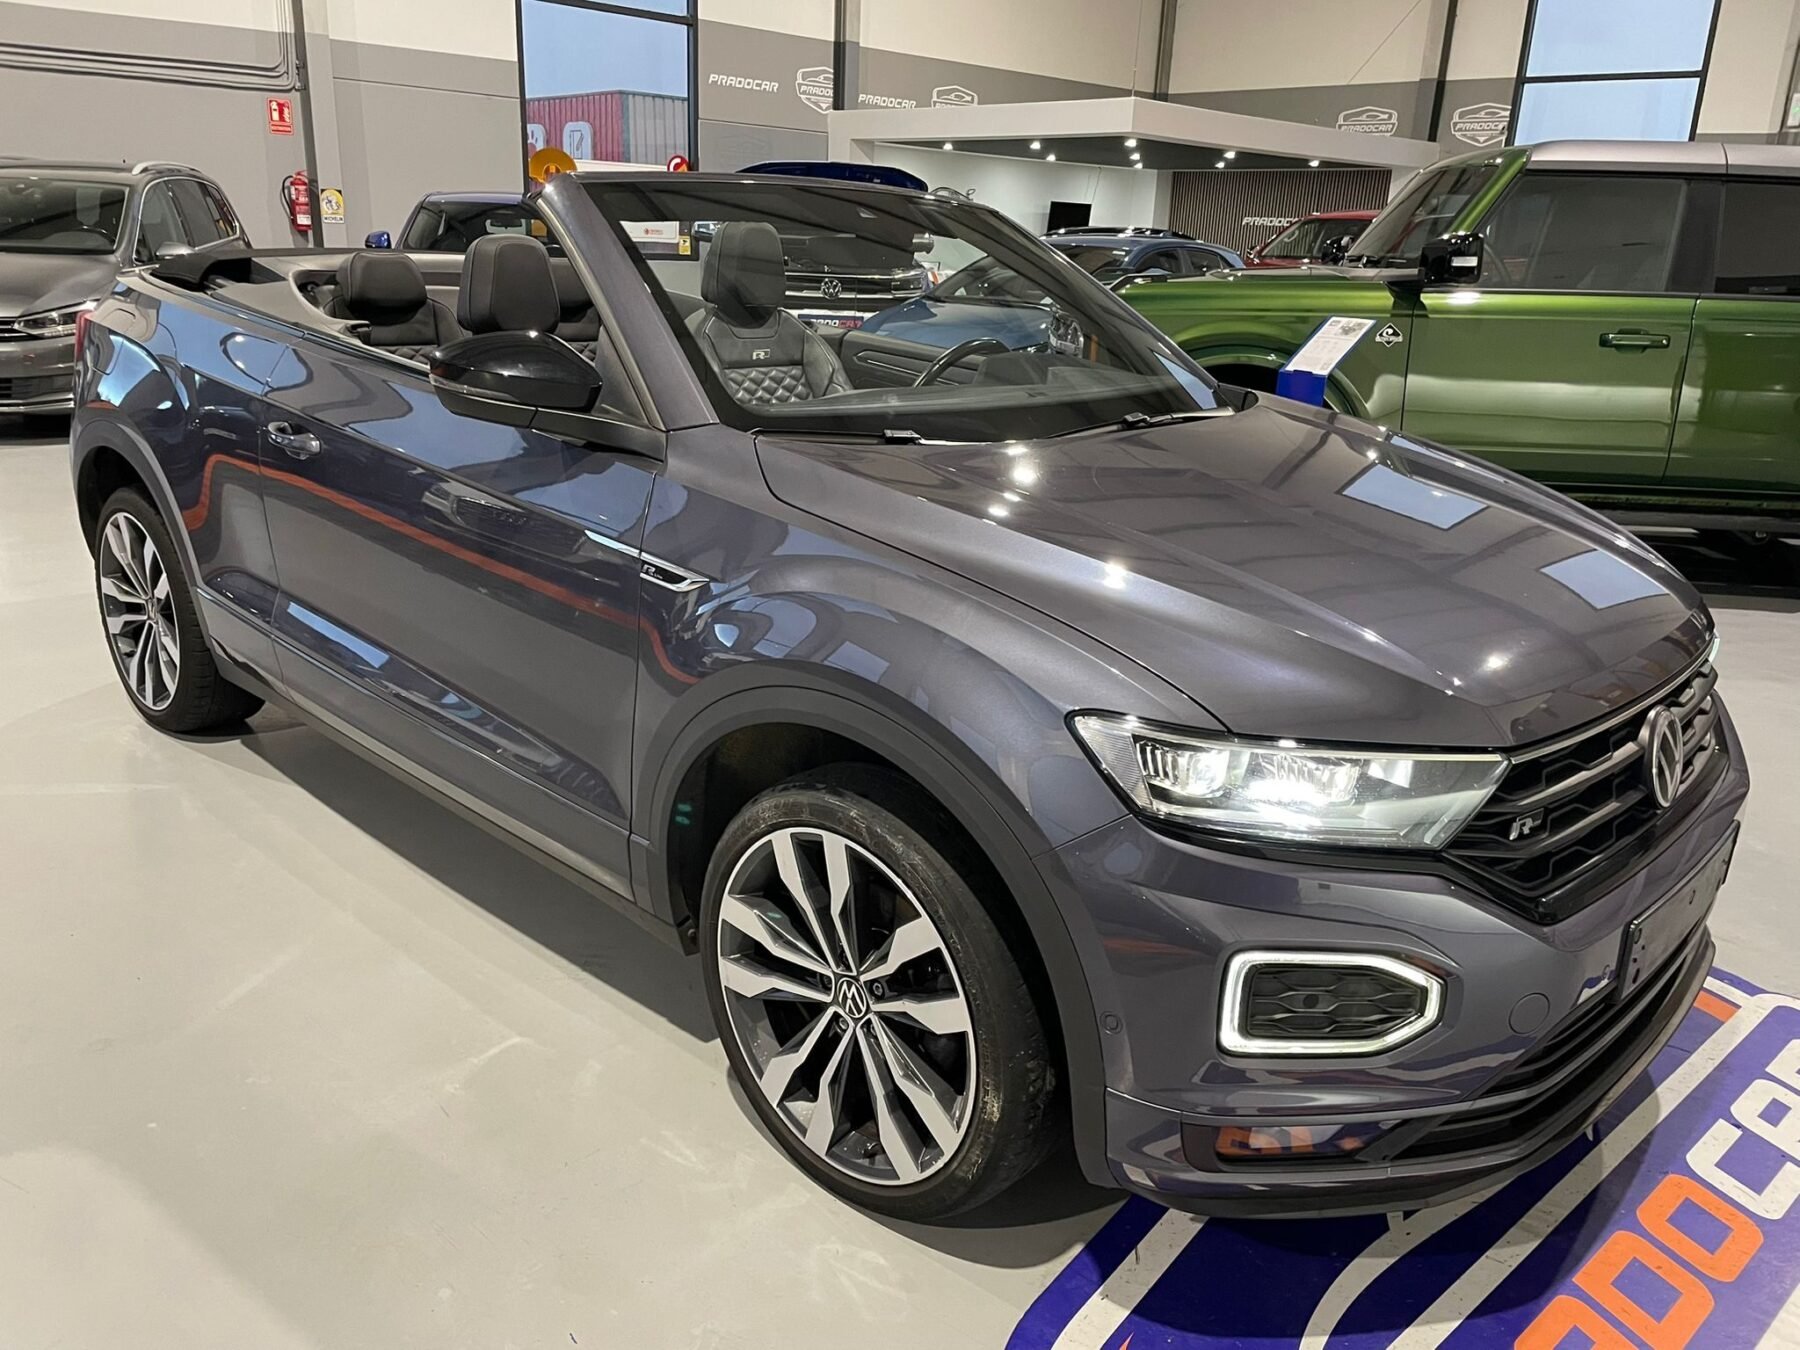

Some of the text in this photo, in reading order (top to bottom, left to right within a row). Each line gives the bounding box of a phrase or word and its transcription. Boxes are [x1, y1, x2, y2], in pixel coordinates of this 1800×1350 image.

[708, 73, 779, 93] PRADOCAR
[800, 85, 833, 97] PRADO
[858, 93, 916, 109] PRADOCAR
[1242, 216, 1298, 226] PRADOC
